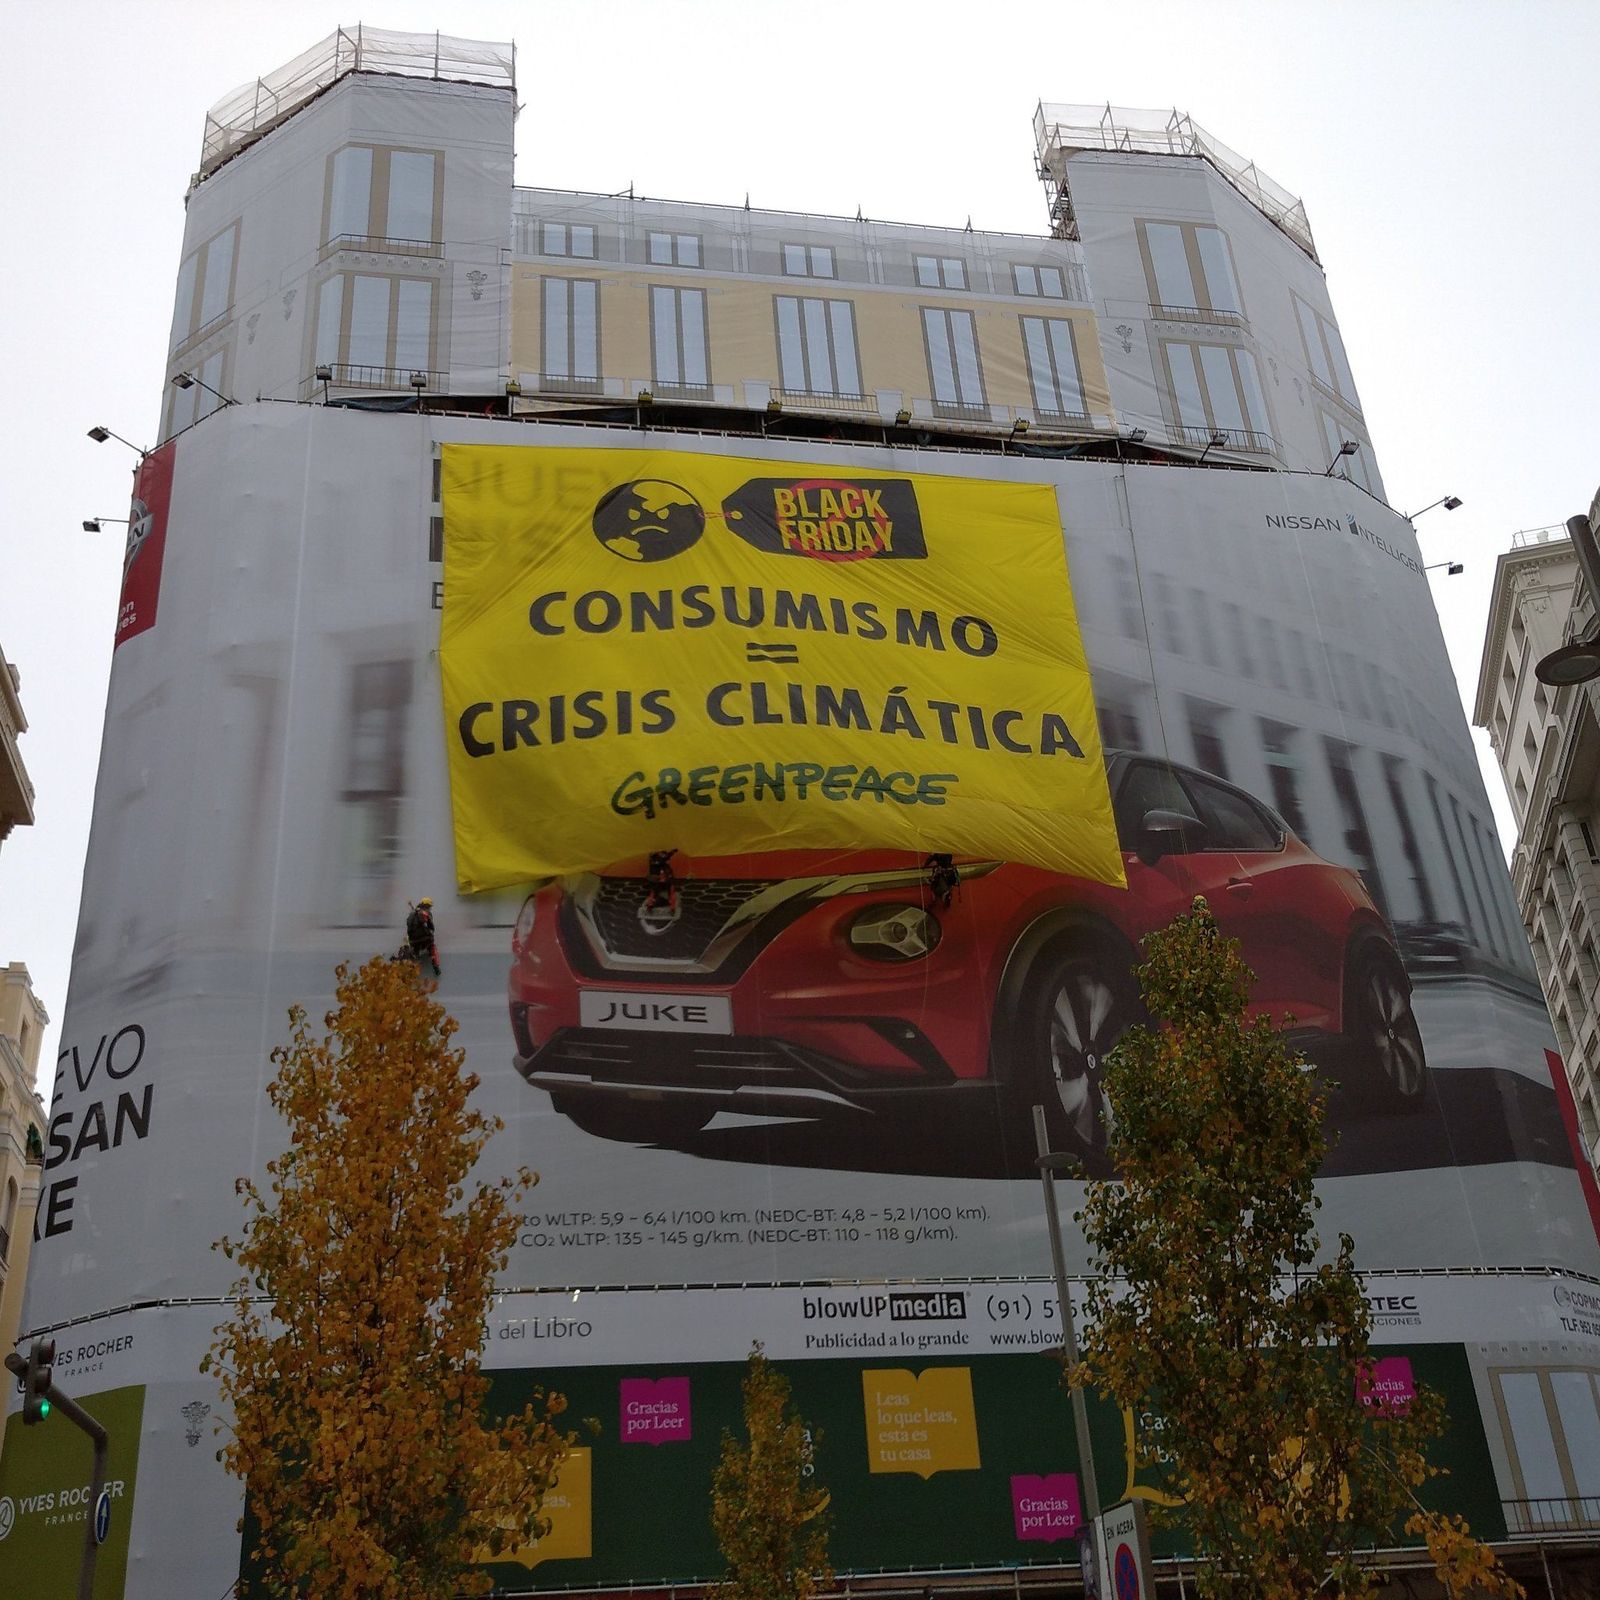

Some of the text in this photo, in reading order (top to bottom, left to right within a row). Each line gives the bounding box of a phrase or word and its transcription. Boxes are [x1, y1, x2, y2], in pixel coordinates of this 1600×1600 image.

[774, 488, 889, 519] BLACK
[1266, 514, 1342, 532] NISSAN
[778, 520, 893, 552] FRIDAY
[529, 585, 998, 657] CONSUMISMO
[459, 682, 1085, 758] CRISIS CLIMÁTICA
[611, 762, 960, 820] GREENPEACE
[599, 1002, 709, 1024] JUKE
[546, 1212, 596, 1227] WLTP:
[601, 1211, 624, 1228] 5,9
[644, 1210, 667, 1228] 6,4
[720, 1209, 749, 1224] km.
[755, 1208, 837, 1225] (NEDC-BT:
[841, 1208, 865, 1224] 4,8
[883, 1207, 906, 1223] 5,2
[956, 1205, 991, 1221] km).
[560, 1231, 610, 1247] WLTP:
[616, 1231, 643, 1246] 135
[660, 1230, 688, 1245] 145
[693, 1229, 744, 1248] g/km.
[748, 1228, 831, 1246] (NEDC-BT:
[835, 1227, 859, 1242] 110
[876, 1227, 899, 1241] 118
[904, 1226, 958, 1244] g/km).
[892, 1293, 964, 1319] media
[987, 1294, 1032, 1321] (91)
[499, 1323, 526, 1340] del
[534, 1317, 592, 1339] Libro
[77, 1335, 134, 1361] ROCHER
[806, 1330, 969, 1350] Publicidad a lo grande
[64, 1362, 104, 1377] FRANCE
[1371, 1378, 1405, 1392] acias
[627, 1400, 679, 1415] Gracias
[876, 1391, 910, 1406] Leas
[627, 1415, 685, 1435] por Leer
[877, 1407, 958, 1429] lo que leas,
[911, 1430, 929, 1442] es
[880, 1447, 932, 1462] tu casa
[19, 1480, 125, 1515] YVES ROCER
[1019, 1497, 1069, 1513] Gracias
[45, 1510, 89, 1527] FRANCE
[1021, 1513, 1076, 1532] por Leer
